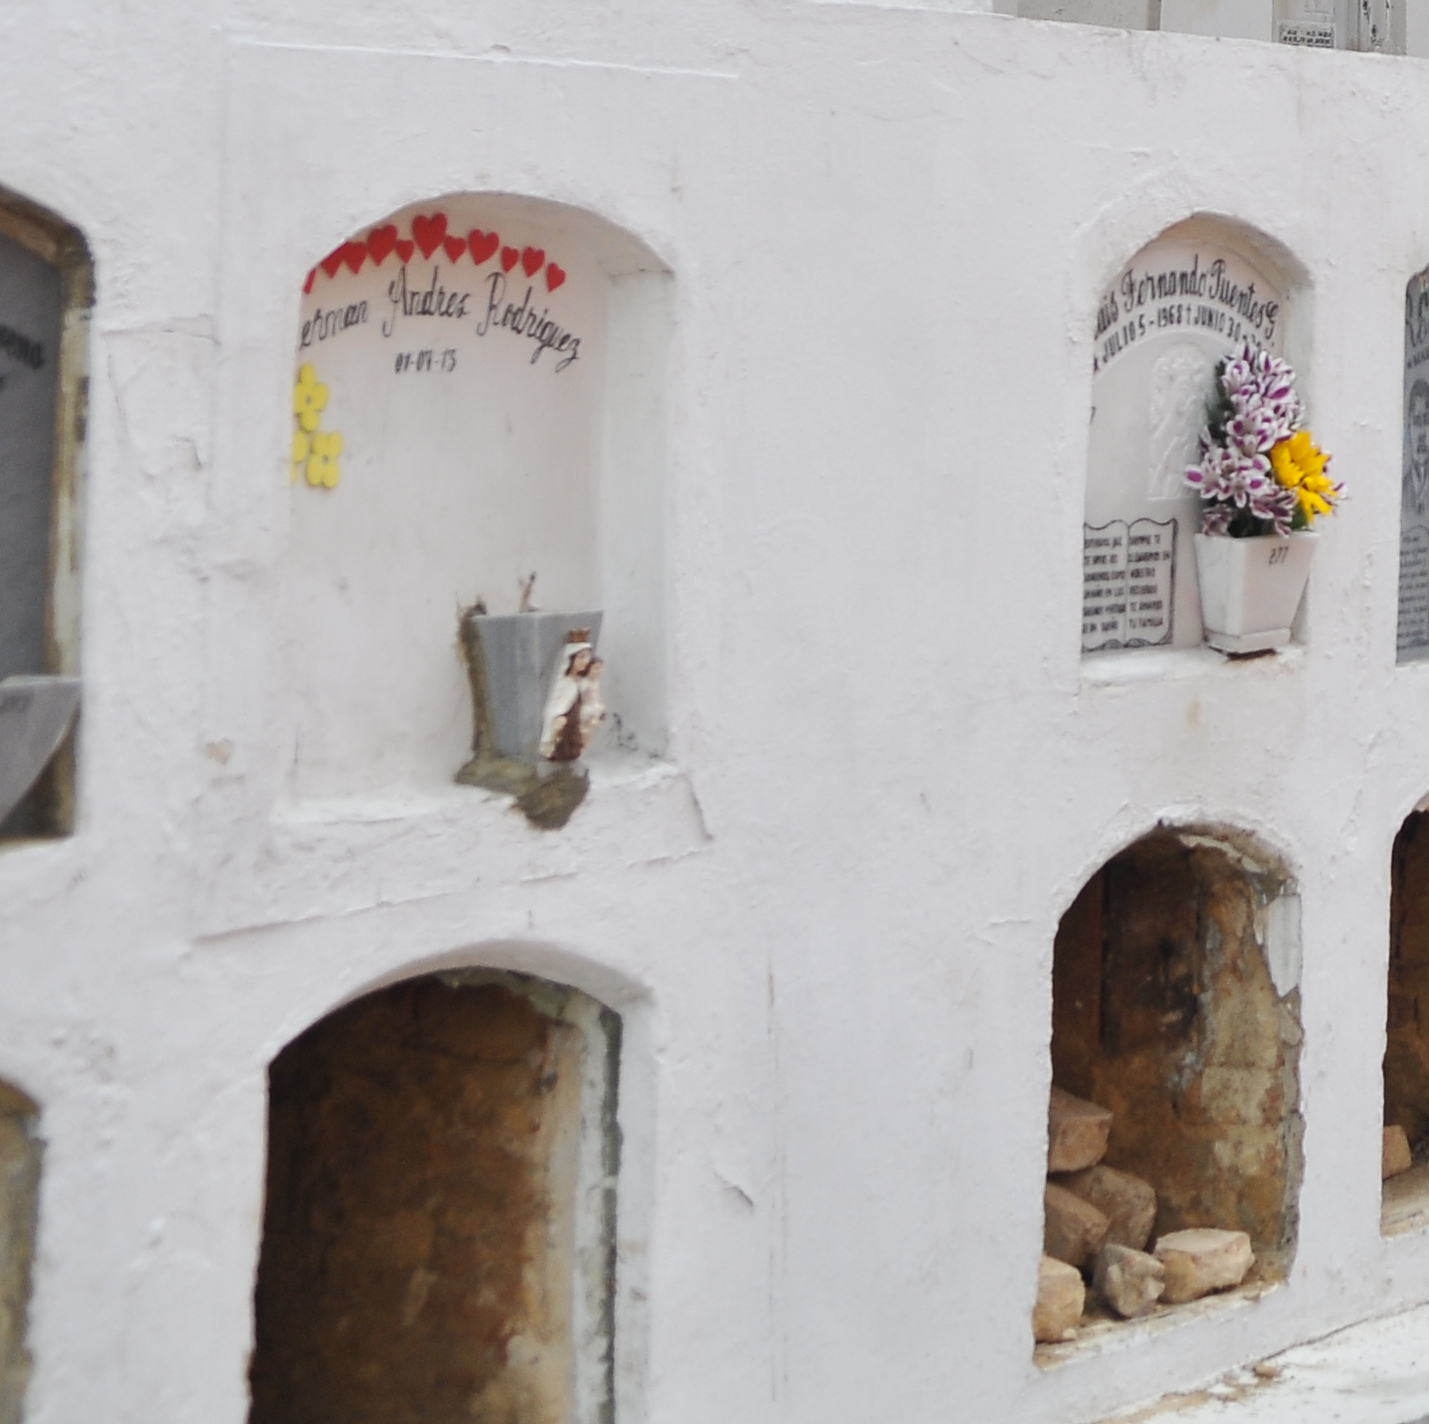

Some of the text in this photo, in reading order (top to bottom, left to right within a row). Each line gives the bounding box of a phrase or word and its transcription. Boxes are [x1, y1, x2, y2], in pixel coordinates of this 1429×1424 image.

[476, 271, 583, 374] Rodriguez
[1095, 288, 1120, 341] uis
[1121, 253, 1204, 313] Fernando
